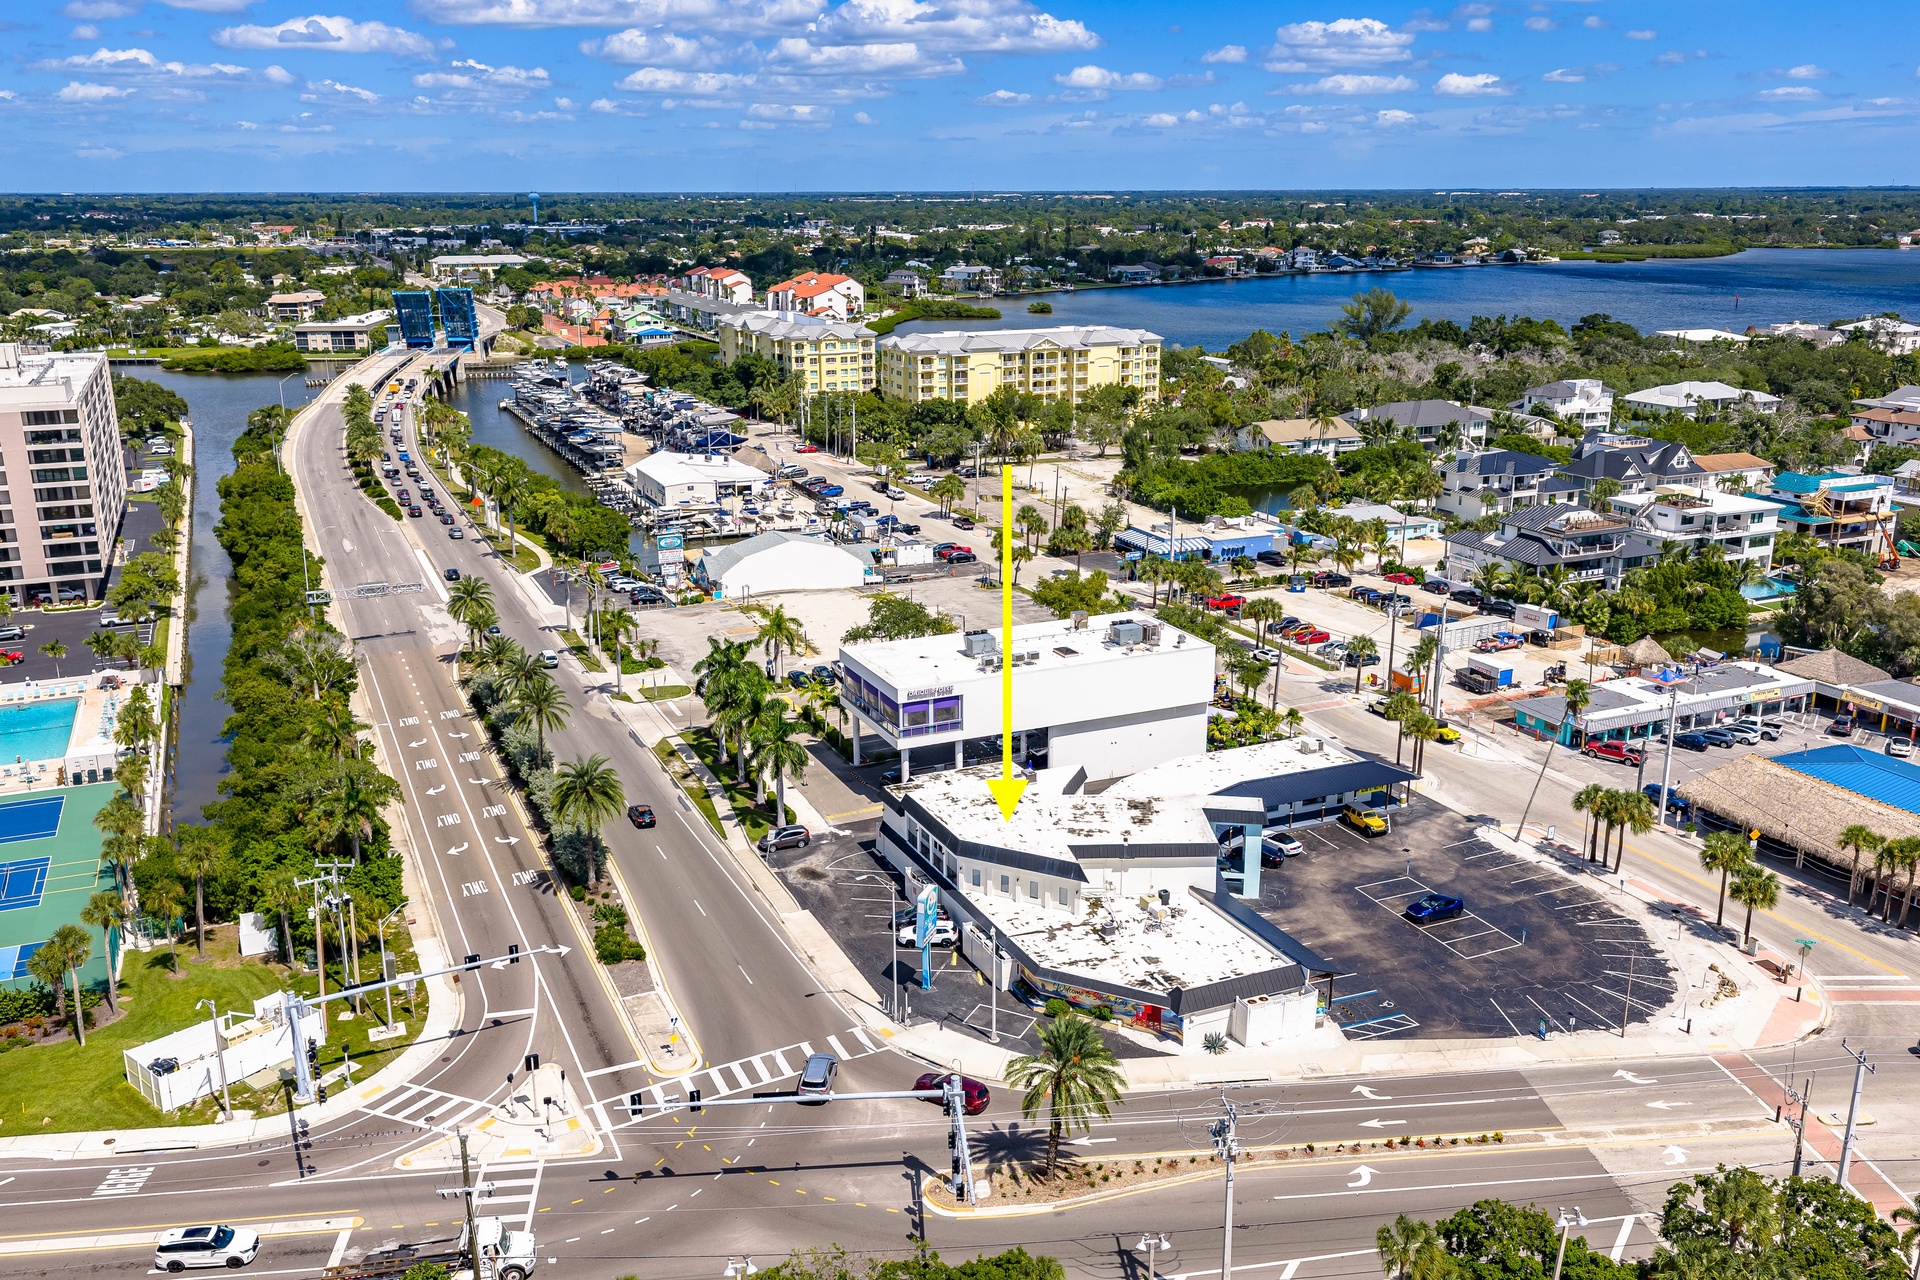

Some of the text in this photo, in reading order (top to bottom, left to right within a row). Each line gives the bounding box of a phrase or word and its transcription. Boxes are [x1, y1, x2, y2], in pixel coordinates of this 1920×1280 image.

[399, 716, 420, 727] ONLY
[440, 709, 460, 720] ONLY
[415, 758, 438, 770] ONLY
[458, 751, 480, 763] ONLY
[482, 804, 507, 818] ONLY
[436, 813, 461, 827] ONLY
[511, 869, 538, 887] ONLY
[461, 880, 489, 897] ONLY
[91, 1167, 156, 1196] MERGE
